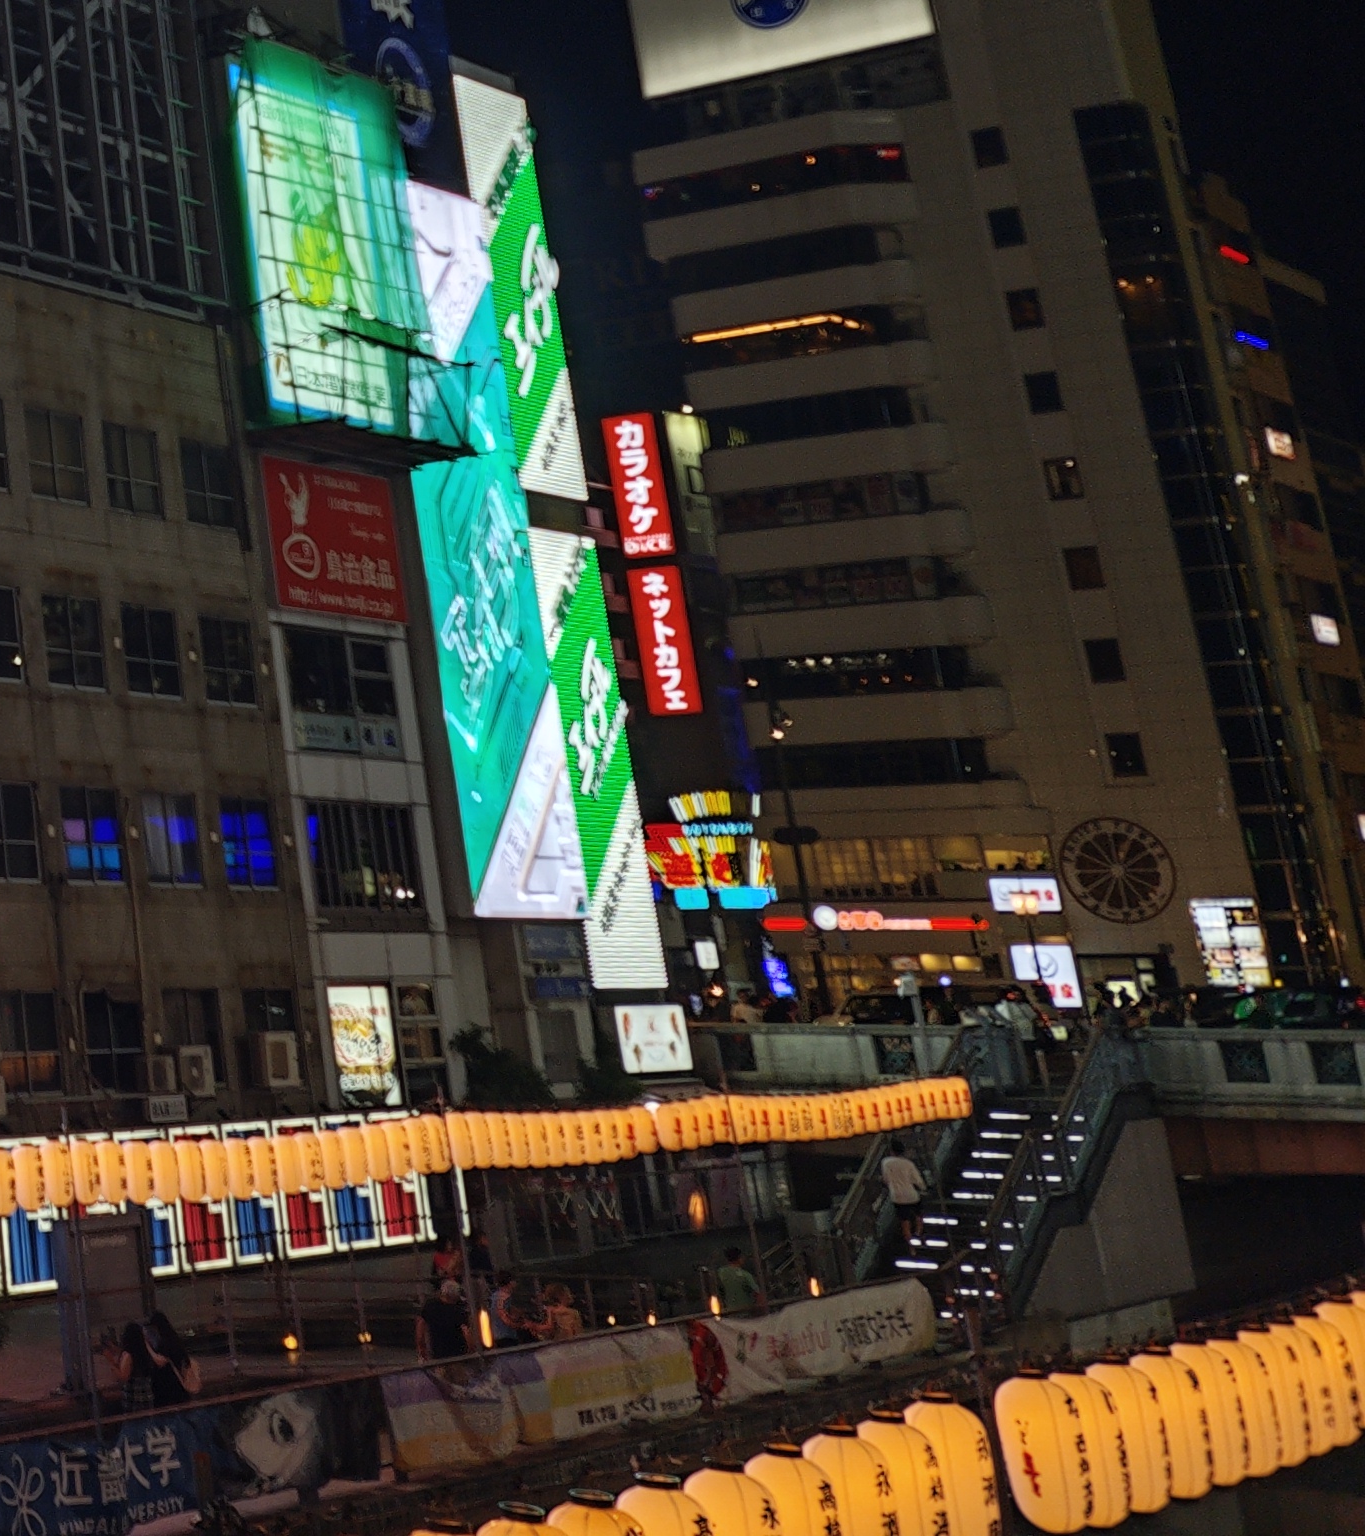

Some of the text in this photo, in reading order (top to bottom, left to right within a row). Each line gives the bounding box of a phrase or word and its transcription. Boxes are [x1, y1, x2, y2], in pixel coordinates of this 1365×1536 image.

[614, 420, 659, 534] カラオケ
[642, 572, 689, 712] ネットカフェ
